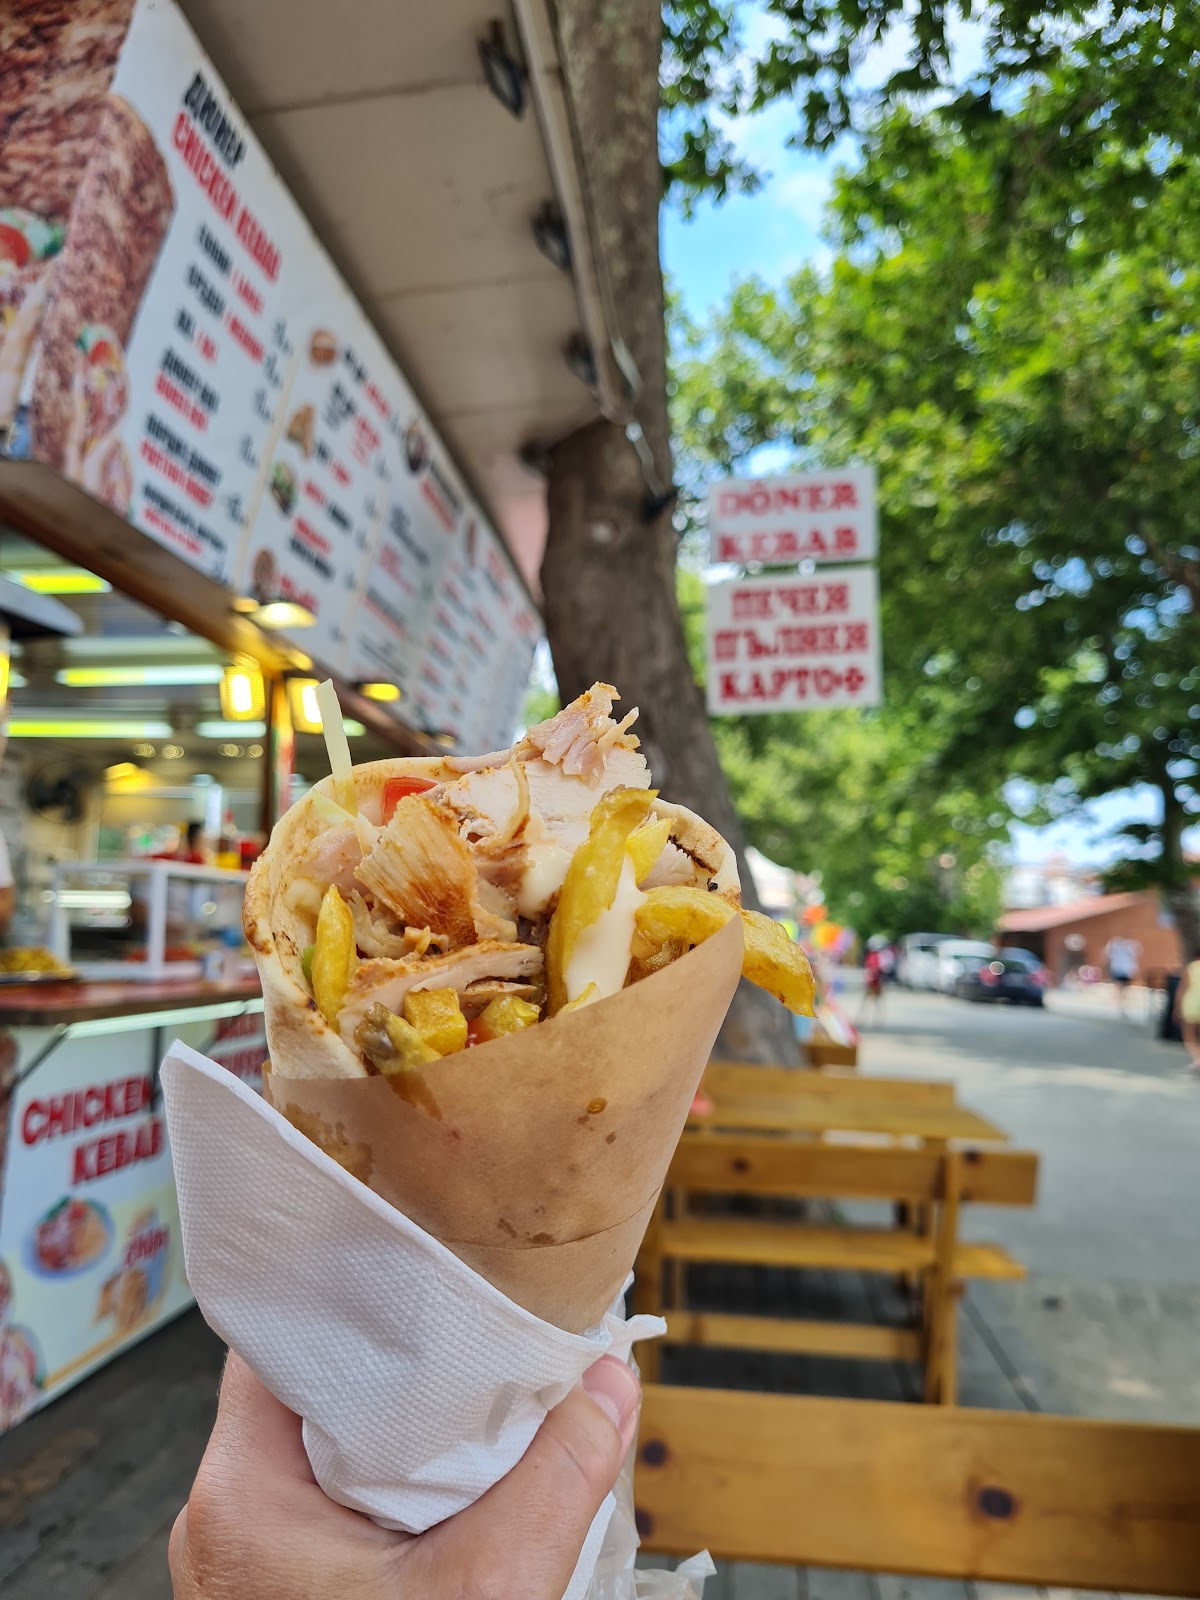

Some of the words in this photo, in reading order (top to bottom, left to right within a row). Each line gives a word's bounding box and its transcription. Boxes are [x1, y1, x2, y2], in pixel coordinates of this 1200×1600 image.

[172, 112, 238, 224] CHICKEN
[236, 209, 281, 282] KEBAB
[717, 481, 857, 518] DÖNER
[717, 526, 858, 562] KEBAB
[718, 664, 866, 705] КАРТОФ
[71, 1117, 164, 1186] KEBAB
